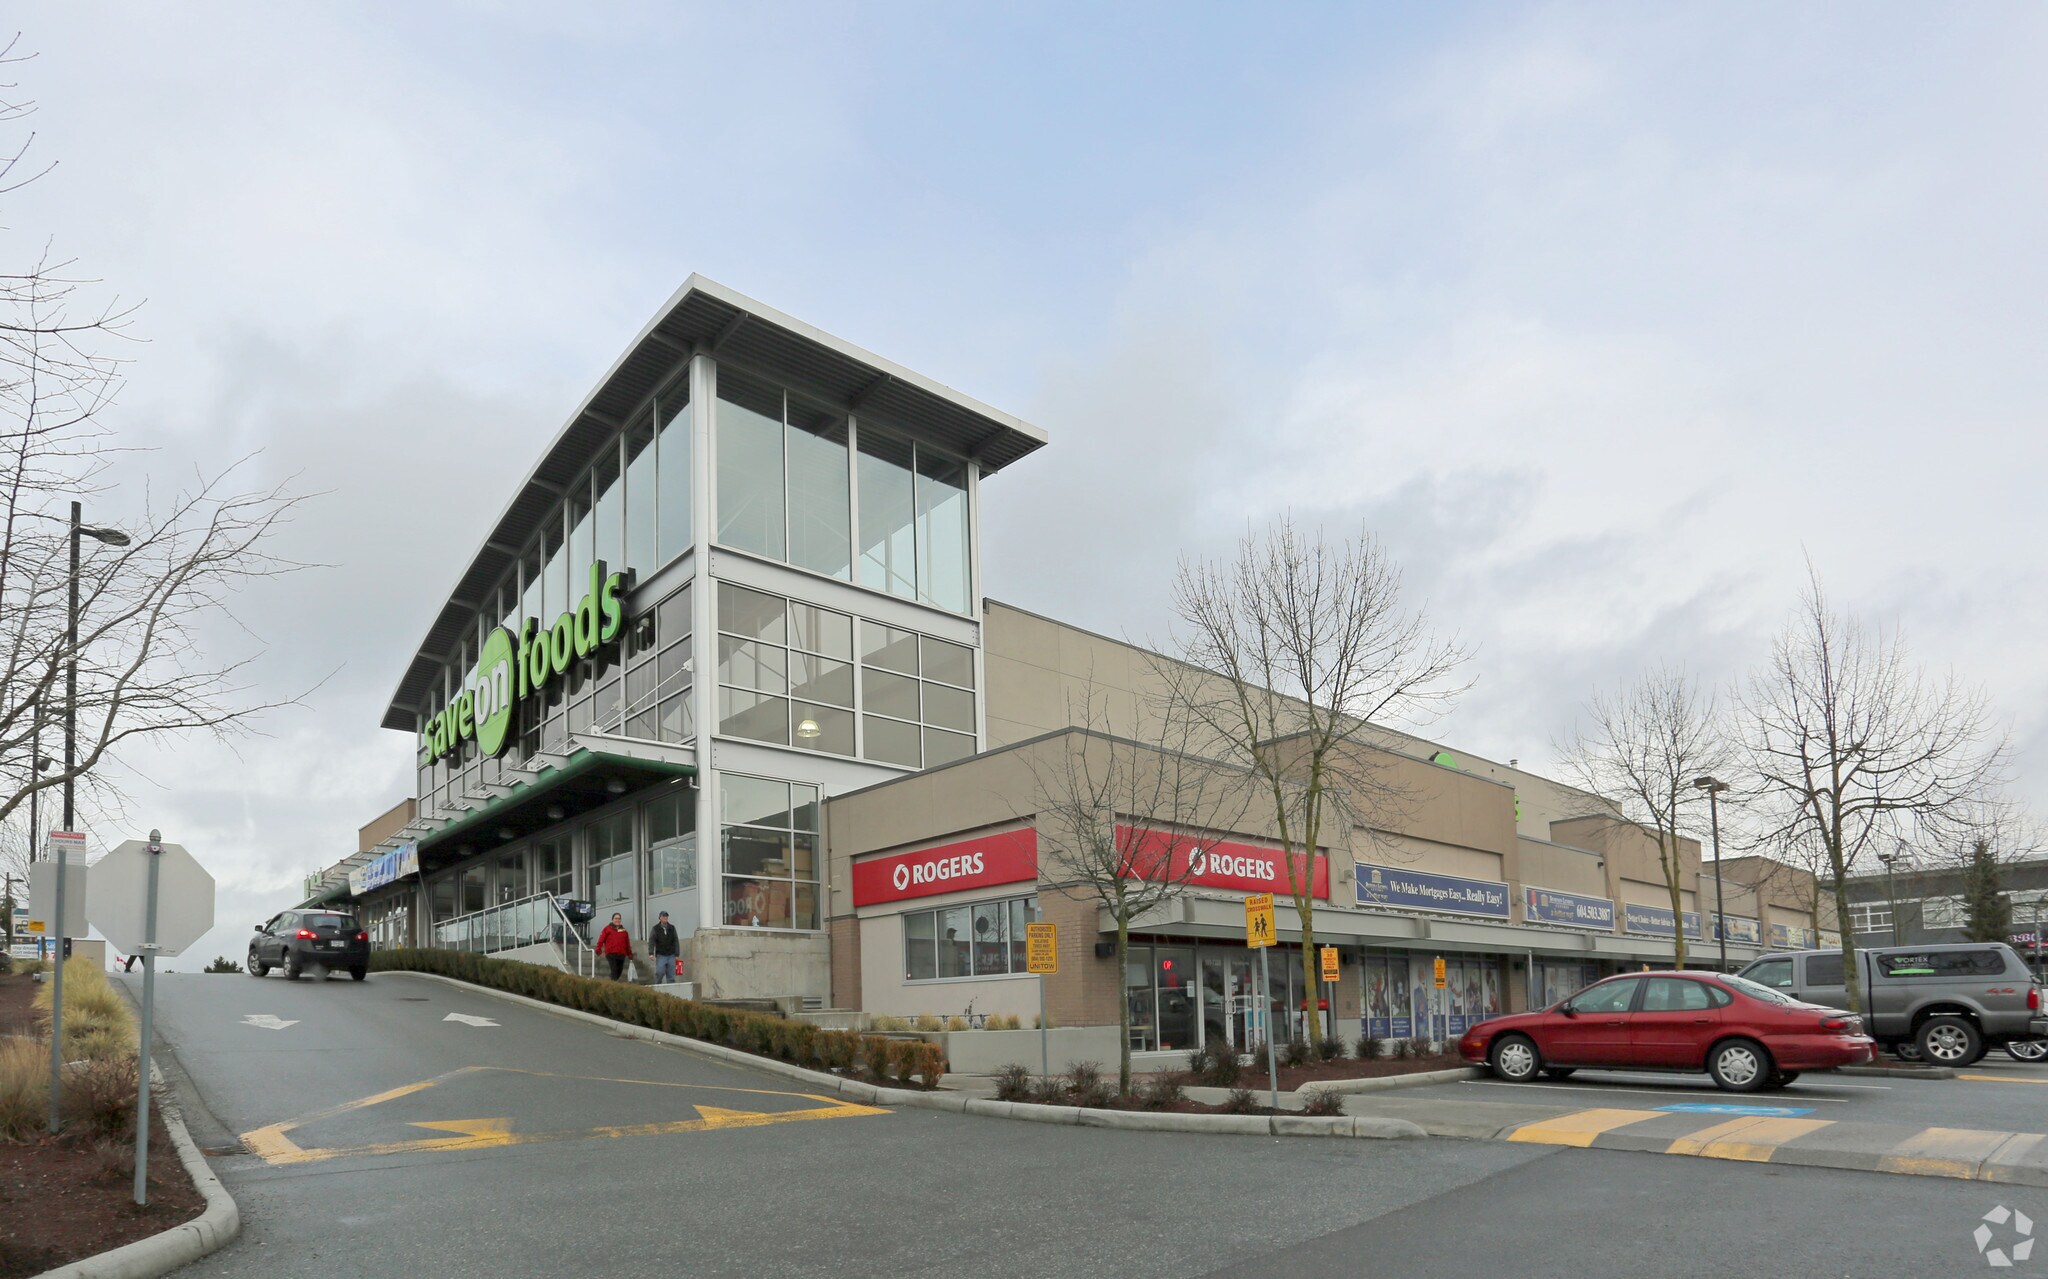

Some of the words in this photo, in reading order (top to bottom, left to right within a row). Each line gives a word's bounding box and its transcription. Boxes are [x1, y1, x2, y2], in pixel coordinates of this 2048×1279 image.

[424, 689, 474, 766] save
[474, 658, 509, 726] on
[518, 559, 622, 700] foods
[913, 852, 984, 884] ROGERS
[1210, 853, 1275, 881] ROGERS
[1250, 897, 1268, 905] RAISED
[1390, 880, 1400, 893] We
[1401, 882, 1418, 895] Make
[1419, 885, 1448, 900] Mortgages
[1467, 889, 1485, 906] Really
[1486, 891, 1503, 907] Easy!
[1247, 904, 1272, 912] CROSSWALK
